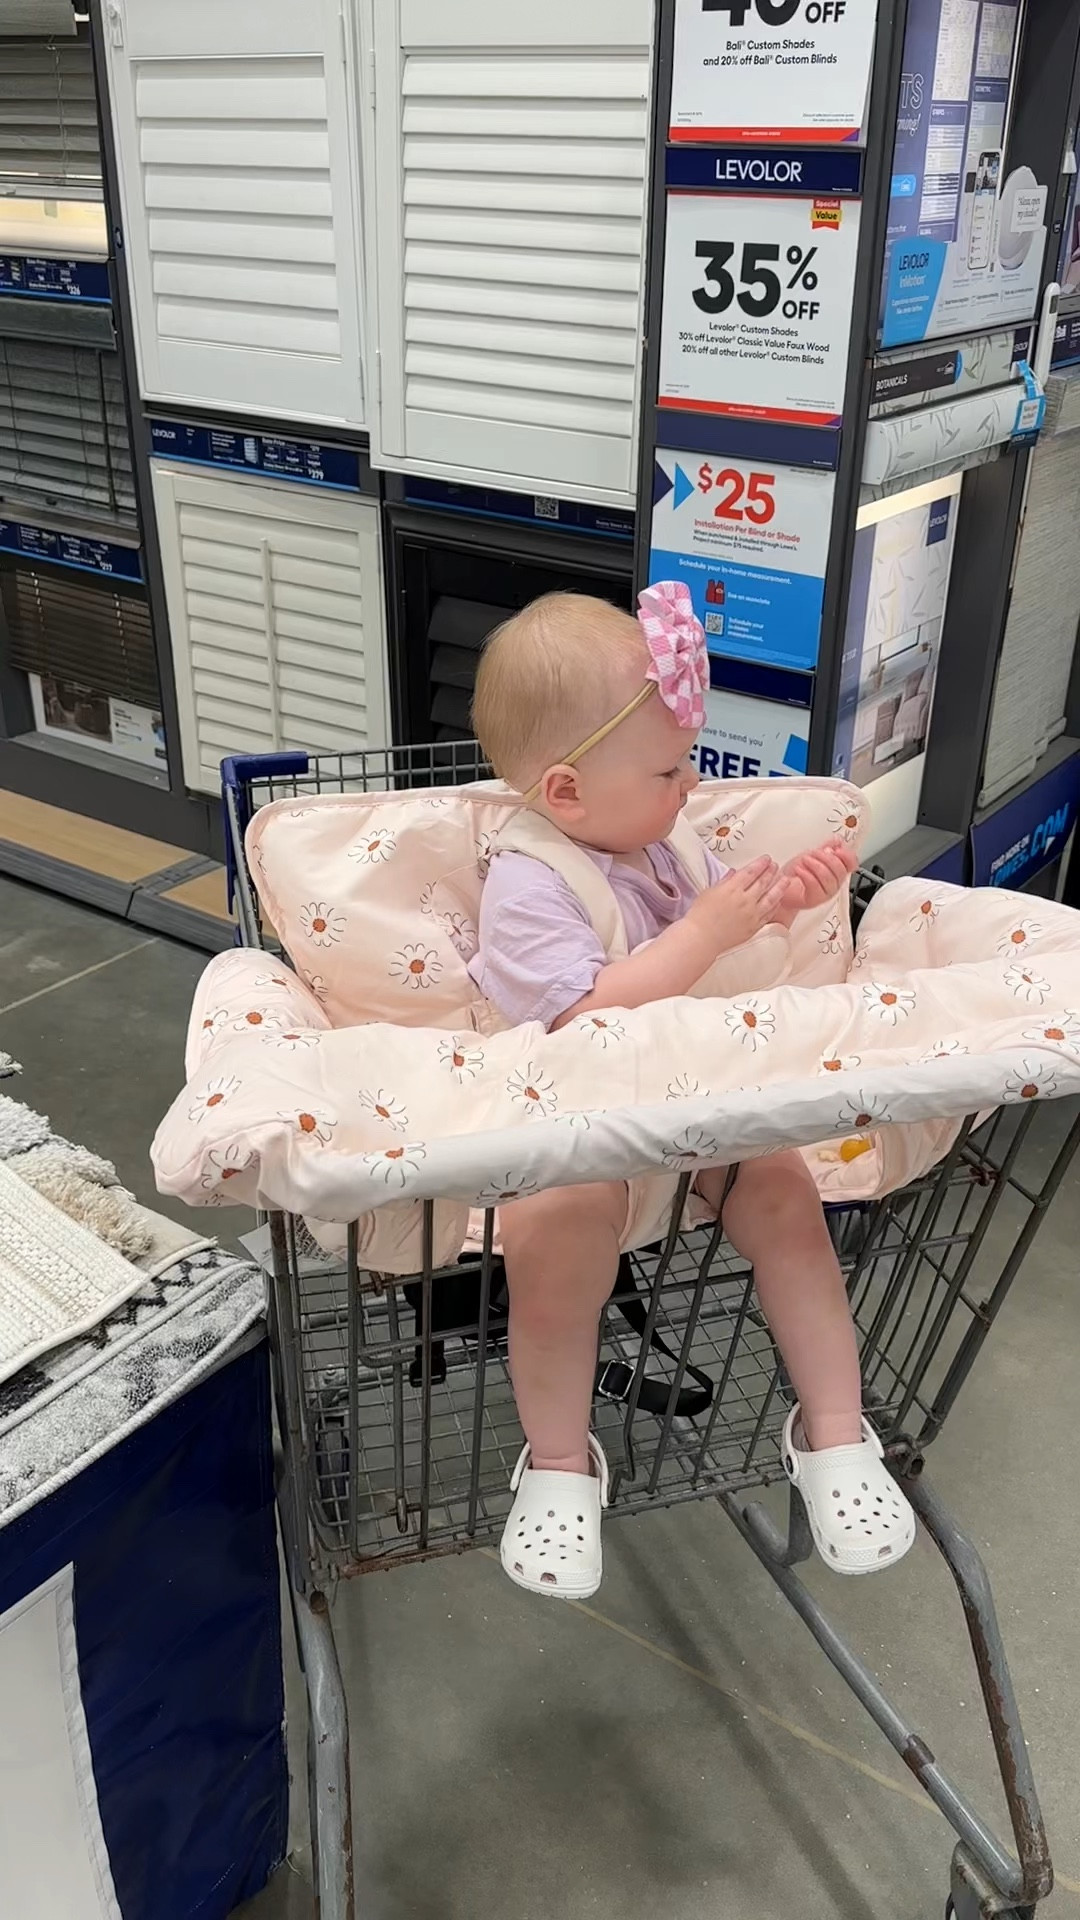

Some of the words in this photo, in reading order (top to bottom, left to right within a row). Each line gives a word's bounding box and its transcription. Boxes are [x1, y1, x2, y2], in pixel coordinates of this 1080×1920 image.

[805, 1, 846, 24] OFF
[747, 39, 781, 50] Custom
[782, 39, 815, 49] Shades
[703, 56, 719, 66] and
[721, 56, 738, 66] 20%
[740, 55, 753, 66] off
[775, 54, 809, 65] Custom
[811, 53, 837, 64] Blinds
[716, 159, 802, 182] LEVOLOR
[815, 211, 838, 220] Value
[899, 253, 930, 271] LEVOLOR
[782, 300, 820, 320] OFF
[741, 324, 770, 335] Custom
[771, 327, 799, 337] Shades
[678, 331, 694, 341] 30%
[694, 332, 705, 342] off
[737, 336, 763, 347] Classic
[764, 339, 785, 349] Value
[786, 341, 805, 351] Faux
[806, 343, 830, 352] Wood
[682, 344, 697, 353] 20%
[698, 345, 709, 354] off
[709, 345, 719, 356] all
[719, 346, 739, 357] other
[771, 352, 801, 362] Custom
[801, 354, 825, 365] Blinds
[875, 374, 908, 391] BOTANICALS
[698, 462, 776, 525] $25
[694, 519, 734, 532] Installation
[735, 525, 747, 534] Per
[748, 527, 767, 537] Blind
[776, 531, 800, 543] Shade
[679, 558, 707, 570] Schedule
[707, 564, 721, 573] your
[721, 565, 747, 576] in-home
[719, 730, 727, 738] to
[728, 733, 747, 743] send
[748, 738, 763, 747] you
[690, 744, 761, 779] REE
